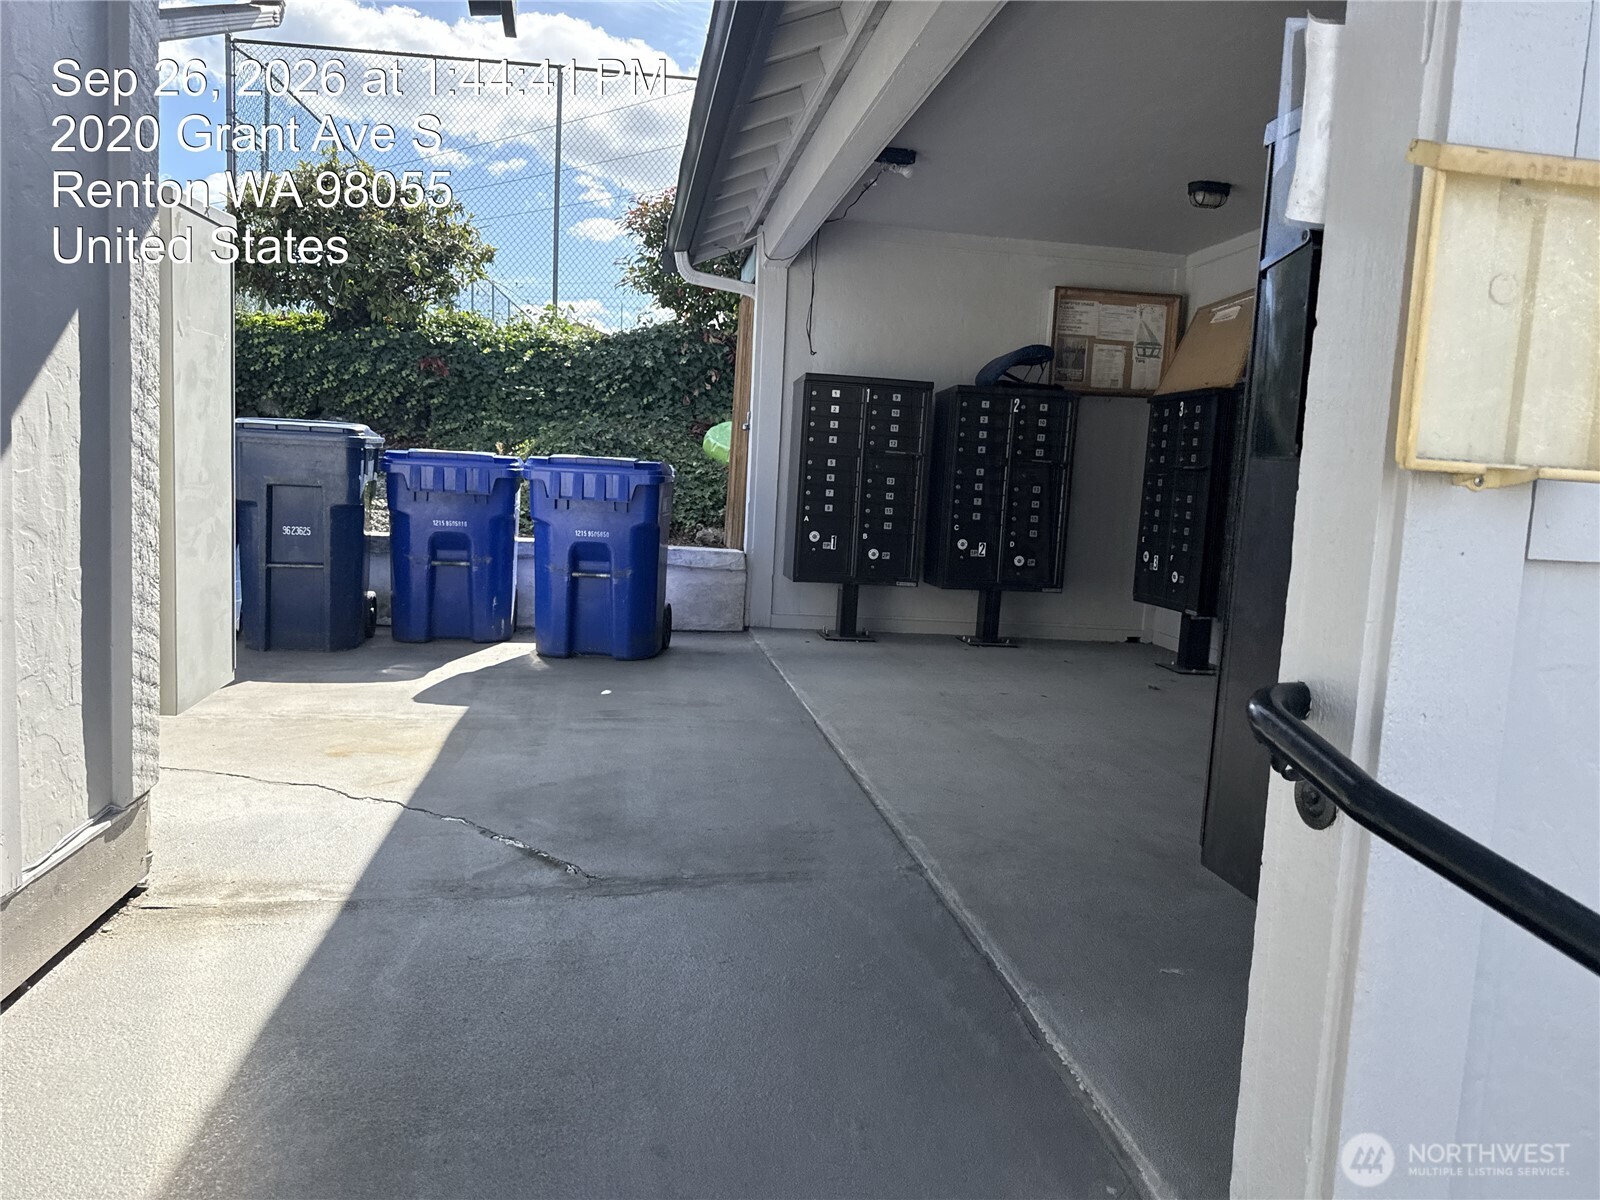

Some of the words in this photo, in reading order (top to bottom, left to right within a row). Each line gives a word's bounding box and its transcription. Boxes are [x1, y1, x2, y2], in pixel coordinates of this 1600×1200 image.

[866, 388, 871, 403] 1
[1013, 398, 1020, 413] 2
[1179, 401, 1184, 417] 3
[979, 543, 985, 556] 2
